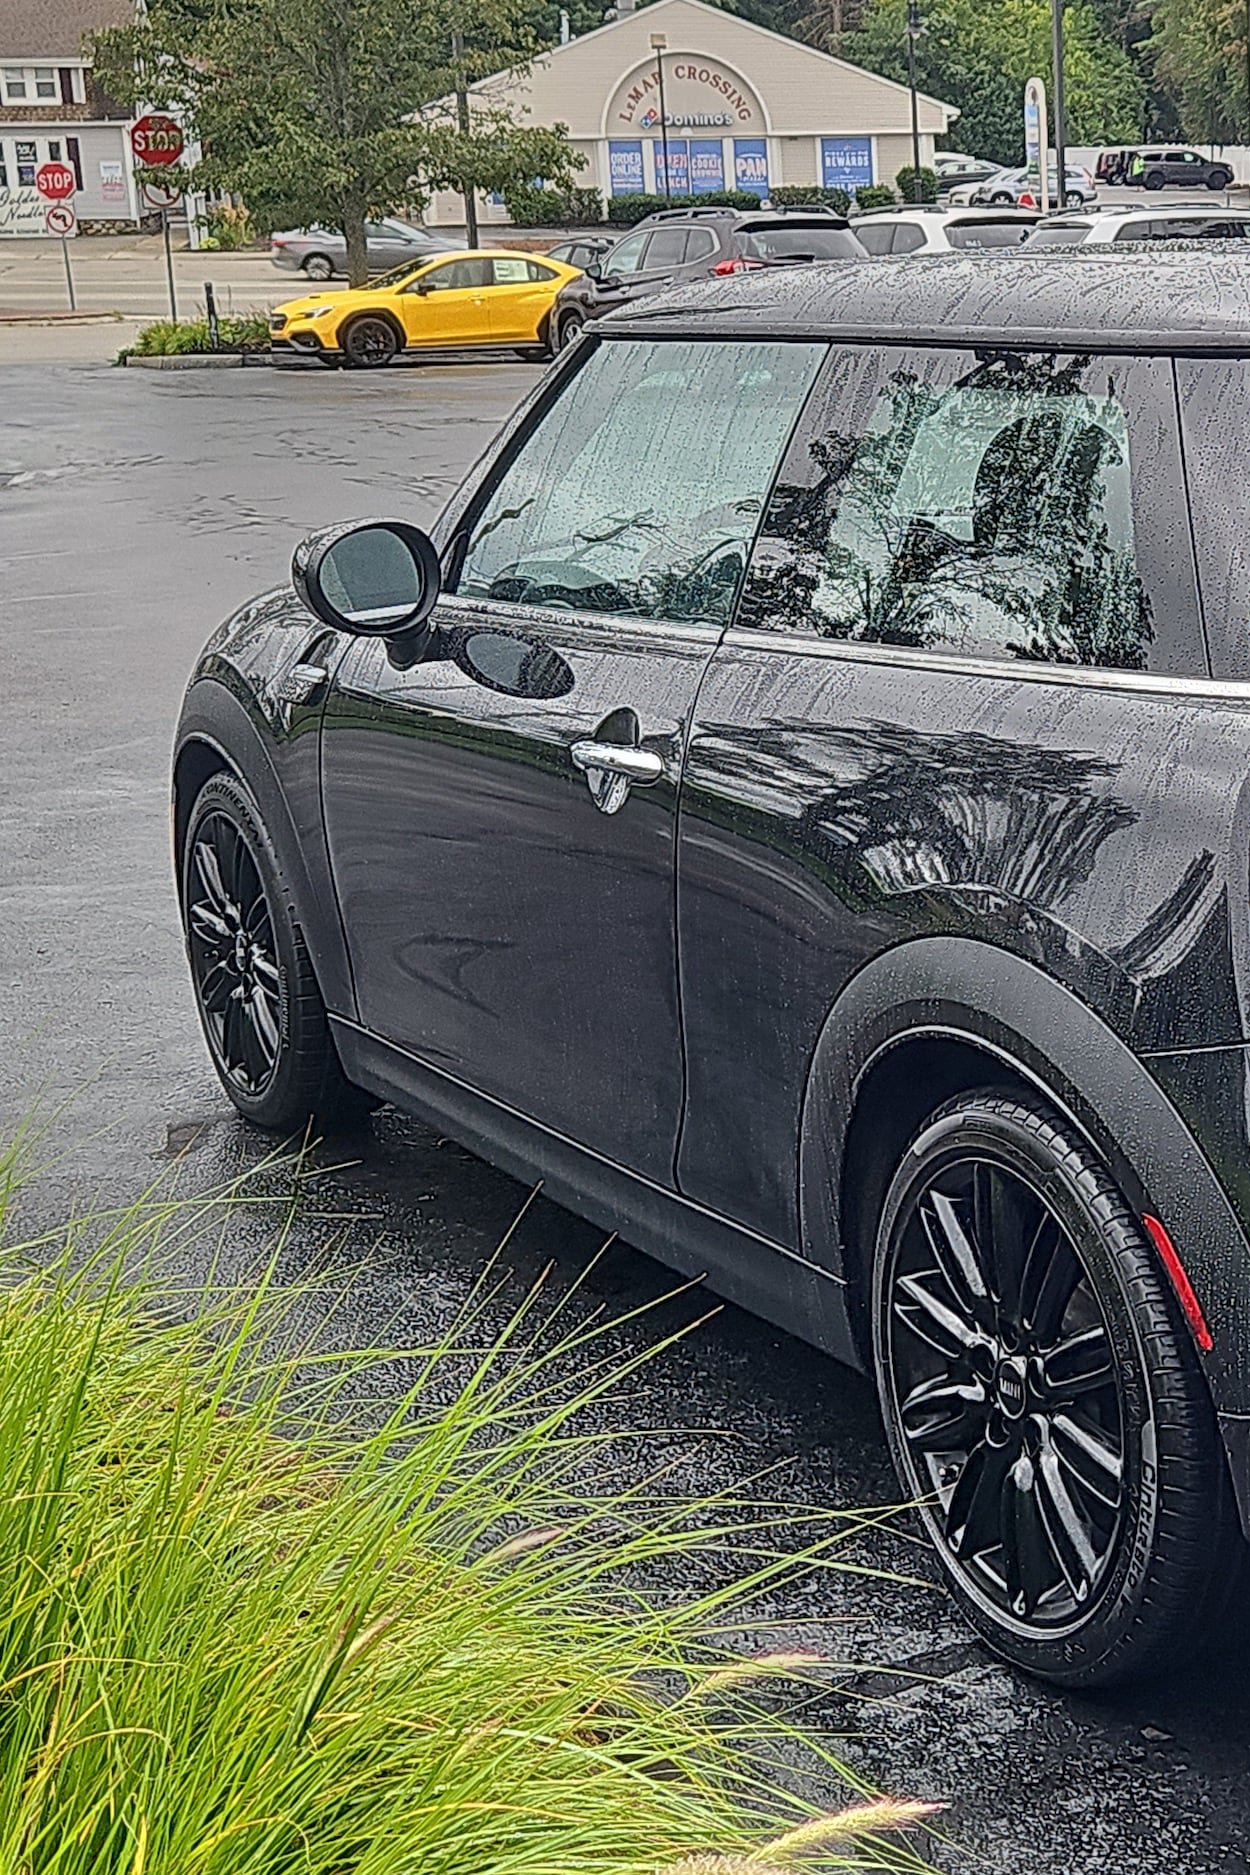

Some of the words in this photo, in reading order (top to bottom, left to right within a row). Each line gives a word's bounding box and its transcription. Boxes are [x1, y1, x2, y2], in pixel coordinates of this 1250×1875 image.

[675, 65, 751, 120] CROSSING
[664, 111, 734, 126] Domino's
[133, 130, 181, 151] STOP
[611, 152, 641, 164] ORDER
[825, 156, 869, 167] REWARDS
[612, 164, 642, 176] ONLINE
[736, 158, 766, 177] PAN
[38, 172, 71, 190] STOP
[999, 1376, 1021, 1401] MINI
